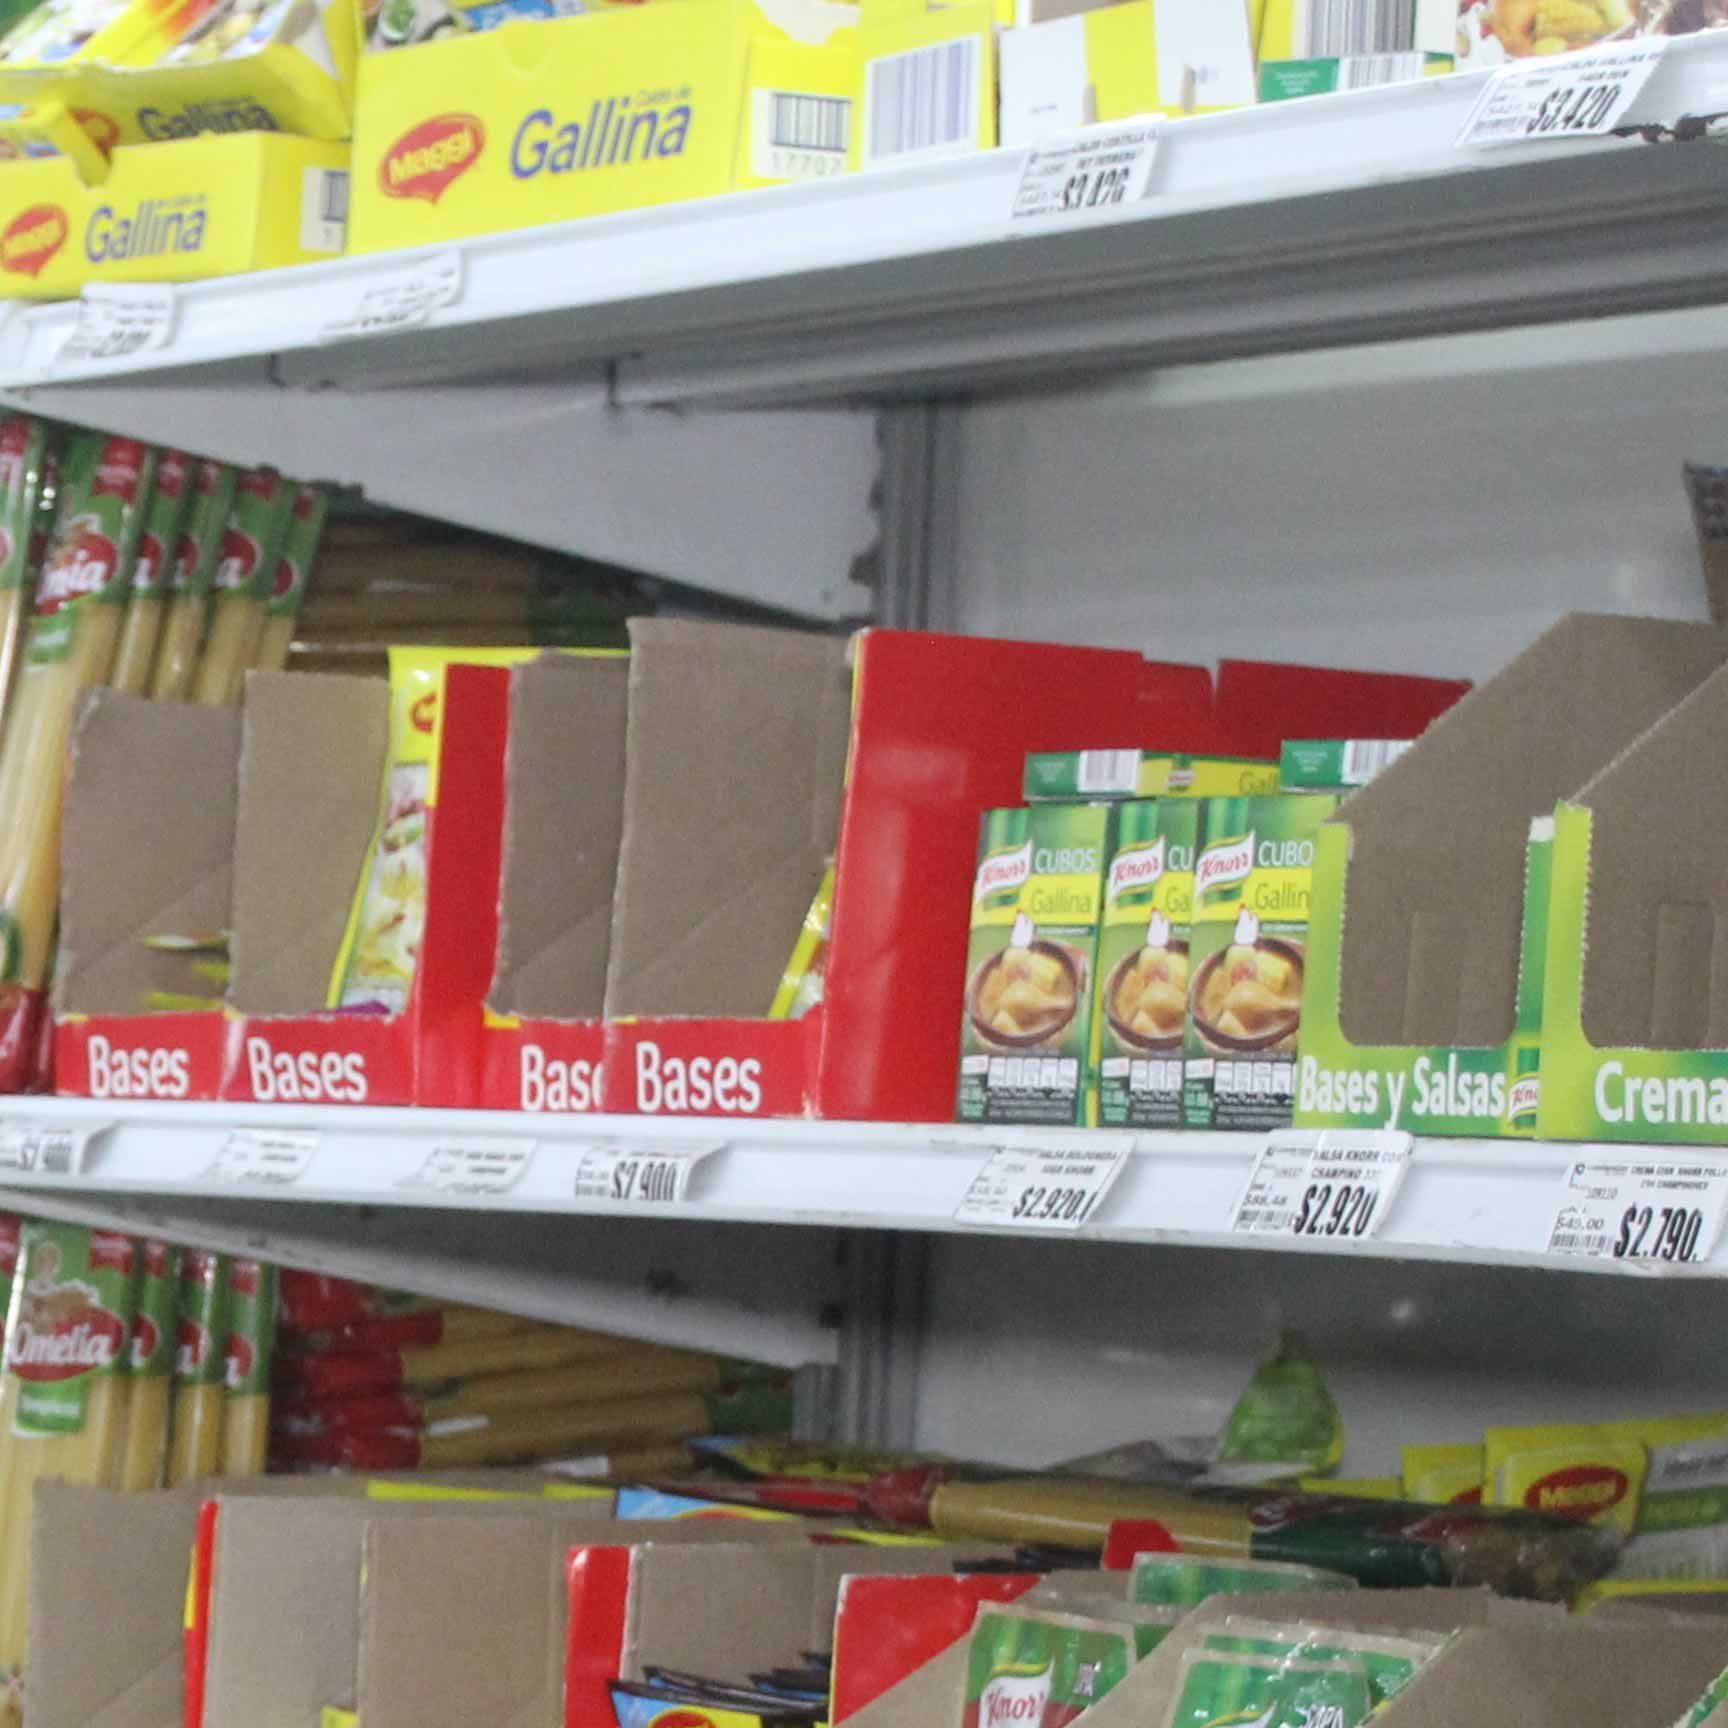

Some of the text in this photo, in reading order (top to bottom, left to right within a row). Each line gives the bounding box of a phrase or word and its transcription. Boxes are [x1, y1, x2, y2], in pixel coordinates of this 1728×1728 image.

[389, 126, 477, 187] Maggi
[508, 95, 692, 180] Gallina
[84, 199, 208, 263] Gallina
[981, 859, 1028, 888] Knorr
[1034, 847, 1095, 873] CUBOS
[1113, 856, 1160, 883] Knorr
[1199, 852, 1249, 882] Knorr
[1259, 840, 1314, 865] CUBO
[1030, 887, 1091, 914] Gallina
[88, 1034, 190, 1099] Bases
[248, 1037, 368, 1104] Bases
[636, 1040, 762, 1113] Bases
[1298, 1052, 1507, 1130] Bases y Salsas
[1595, 1060, 1728, 1126] Crema
[1346, 1149, 1378, 1163] KNORR
